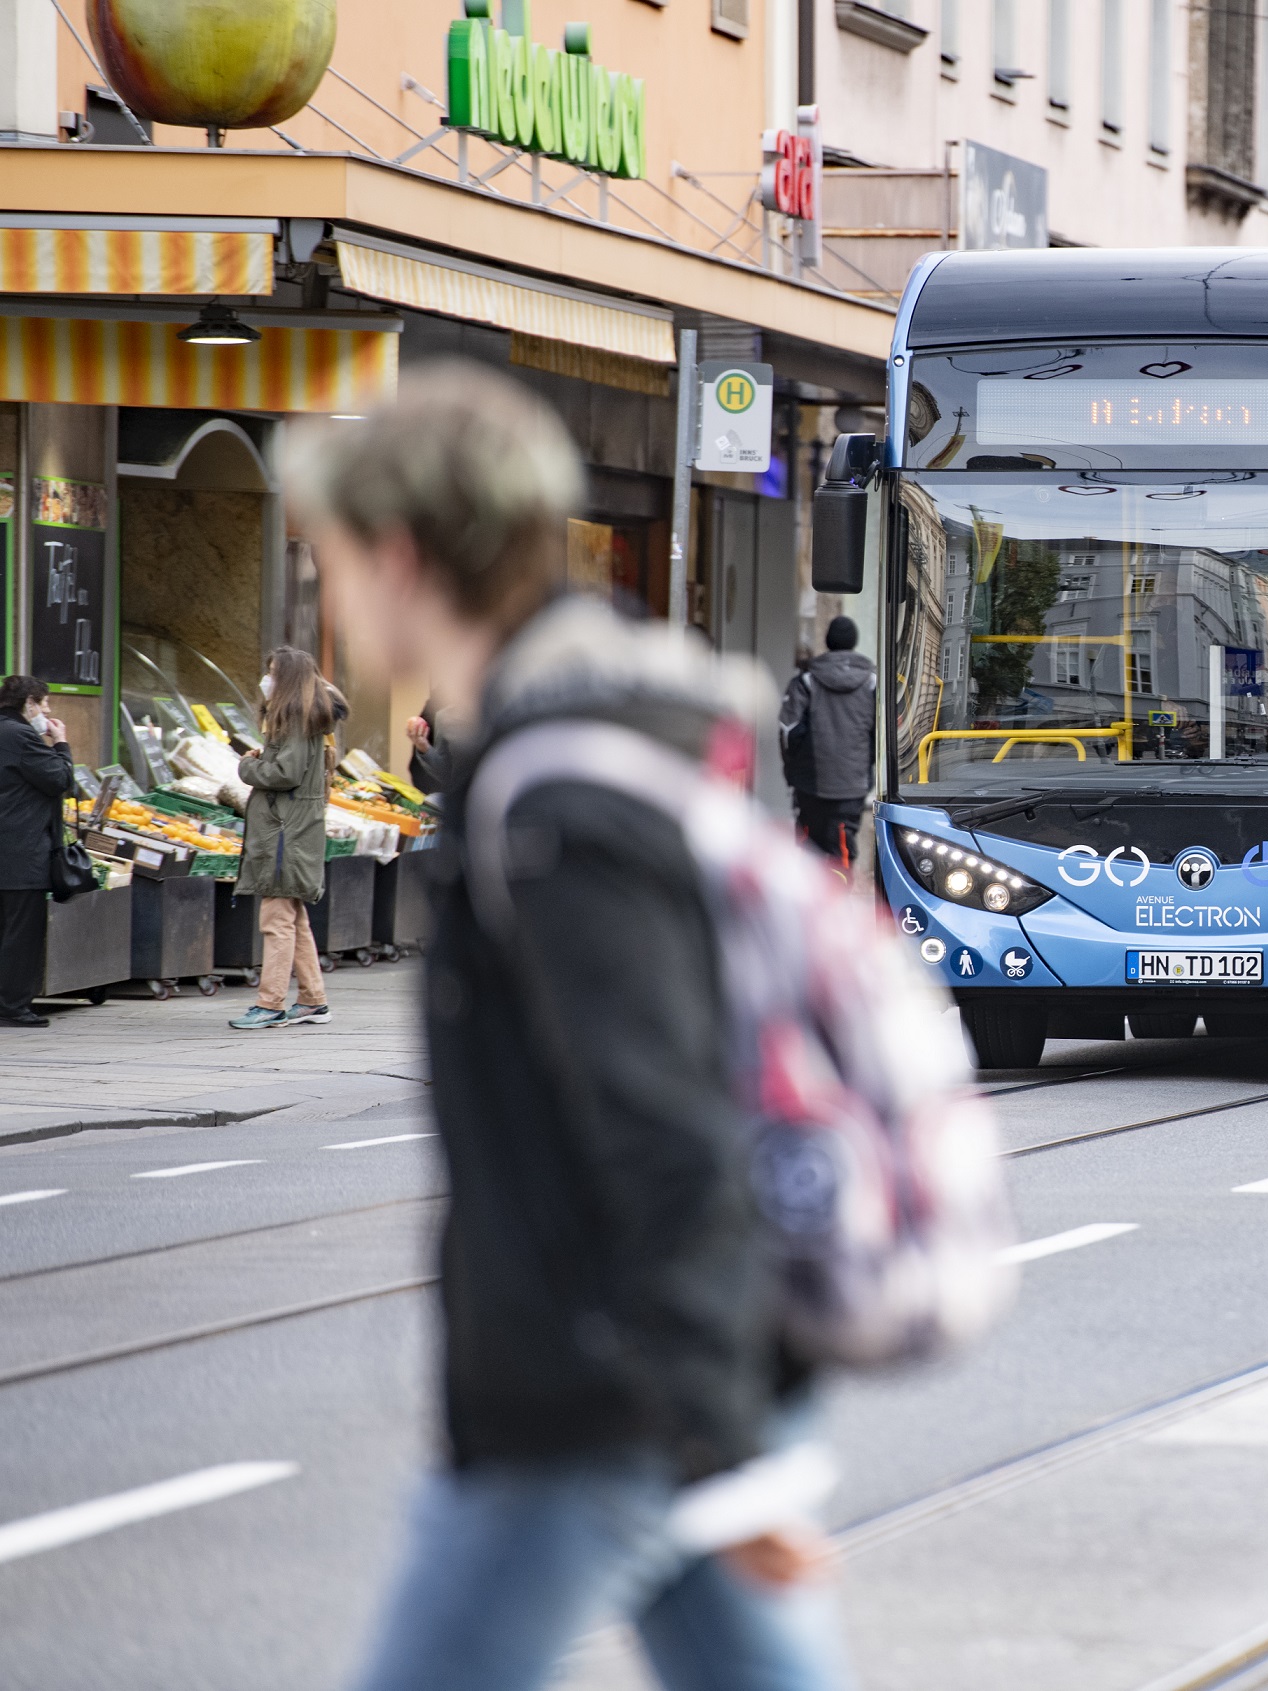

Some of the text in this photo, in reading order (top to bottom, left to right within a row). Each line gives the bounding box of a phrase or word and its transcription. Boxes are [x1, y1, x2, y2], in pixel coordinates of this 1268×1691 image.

[1058, 844, 1150, 887] GO
[1136, 895, 1175, 904] AVENUE
[1135, 905, 1261, 928] ELECTRON
[1141, 955, 1169, 976] HN
